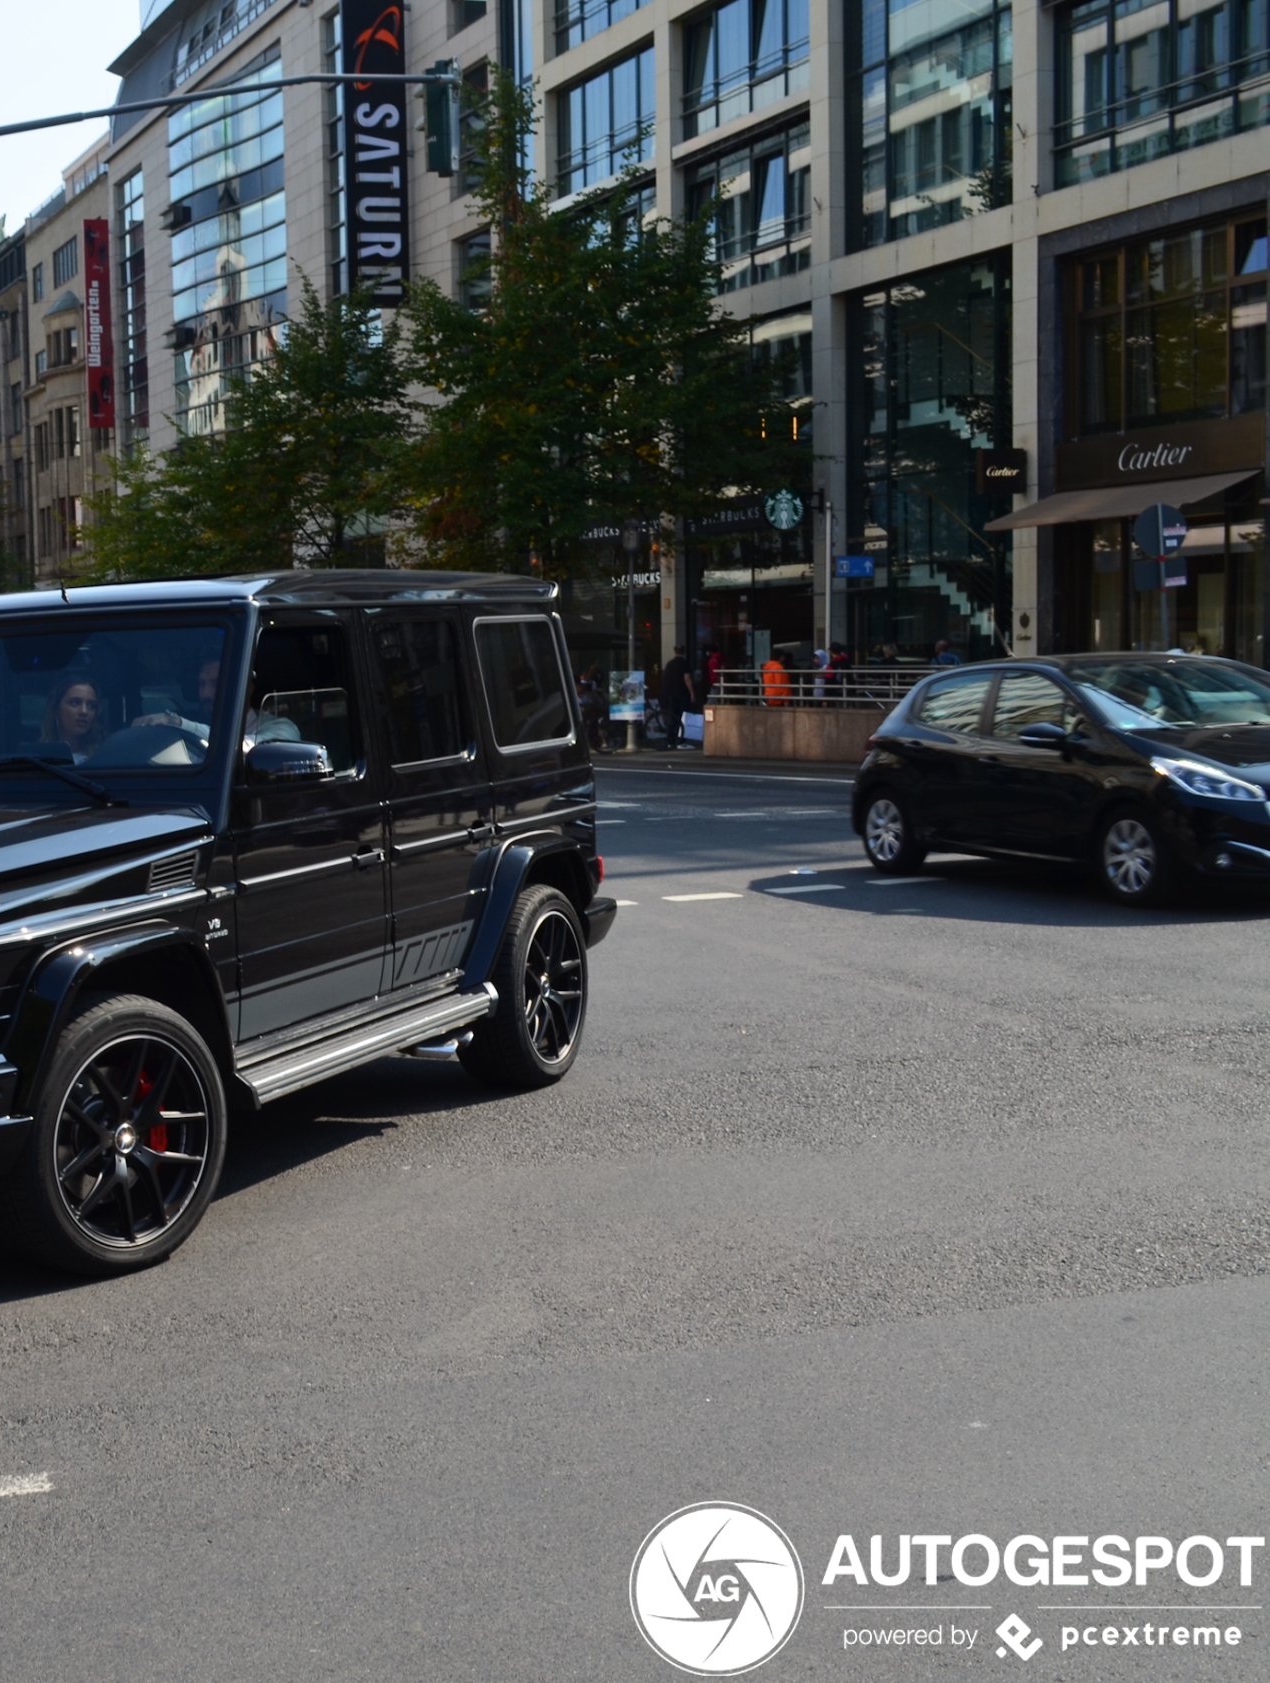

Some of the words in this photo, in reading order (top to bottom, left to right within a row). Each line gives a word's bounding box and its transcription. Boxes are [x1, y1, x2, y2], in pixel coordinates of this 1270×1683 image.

[354, 102, 403, 296] SATURN
[1118, 442, 1193, 472] Cartier
[985, 465, 1020, 477] Cartier
[207, 917, 221, 930] V8
